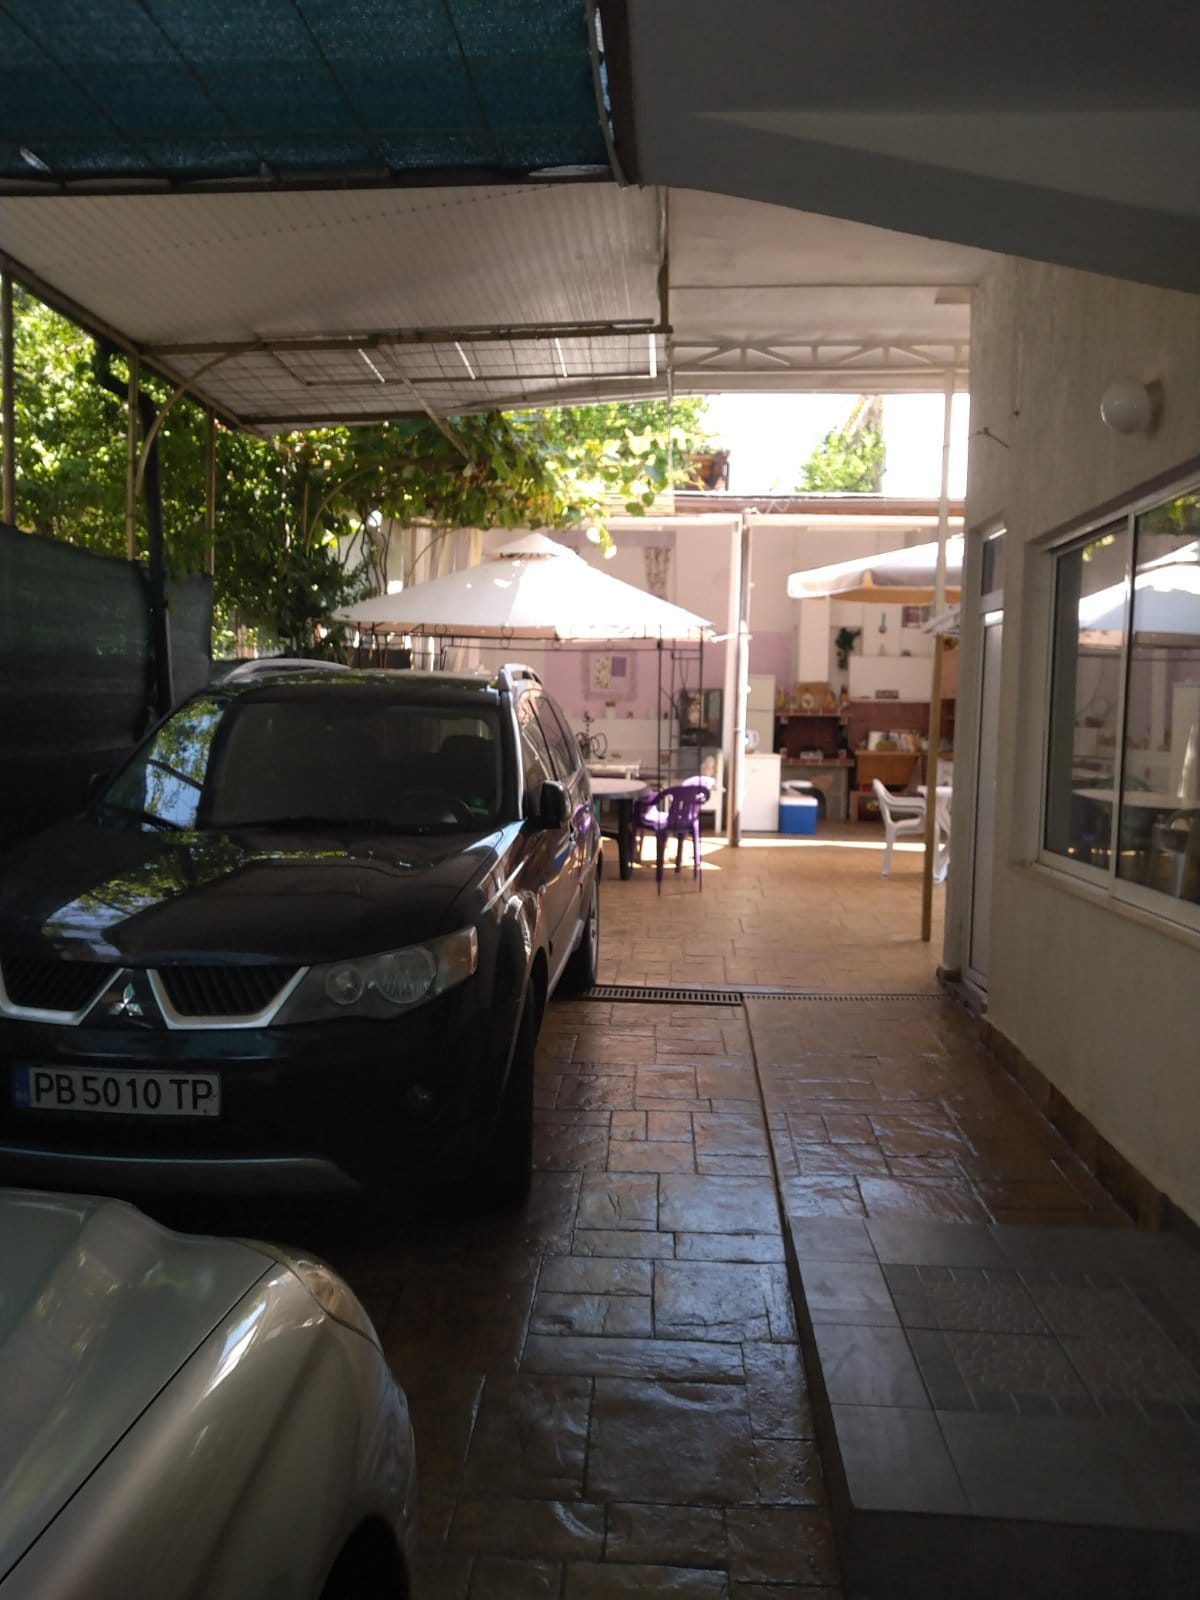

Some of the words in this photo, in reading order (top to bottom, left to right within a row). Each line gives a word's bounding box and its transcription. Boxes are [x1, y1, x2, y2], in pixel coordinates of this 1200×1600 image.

[34, 1072, 76, 1105] PB
[82, 1075, 162, 1109] 5010
[168, 1079, 213, 1111] TP
